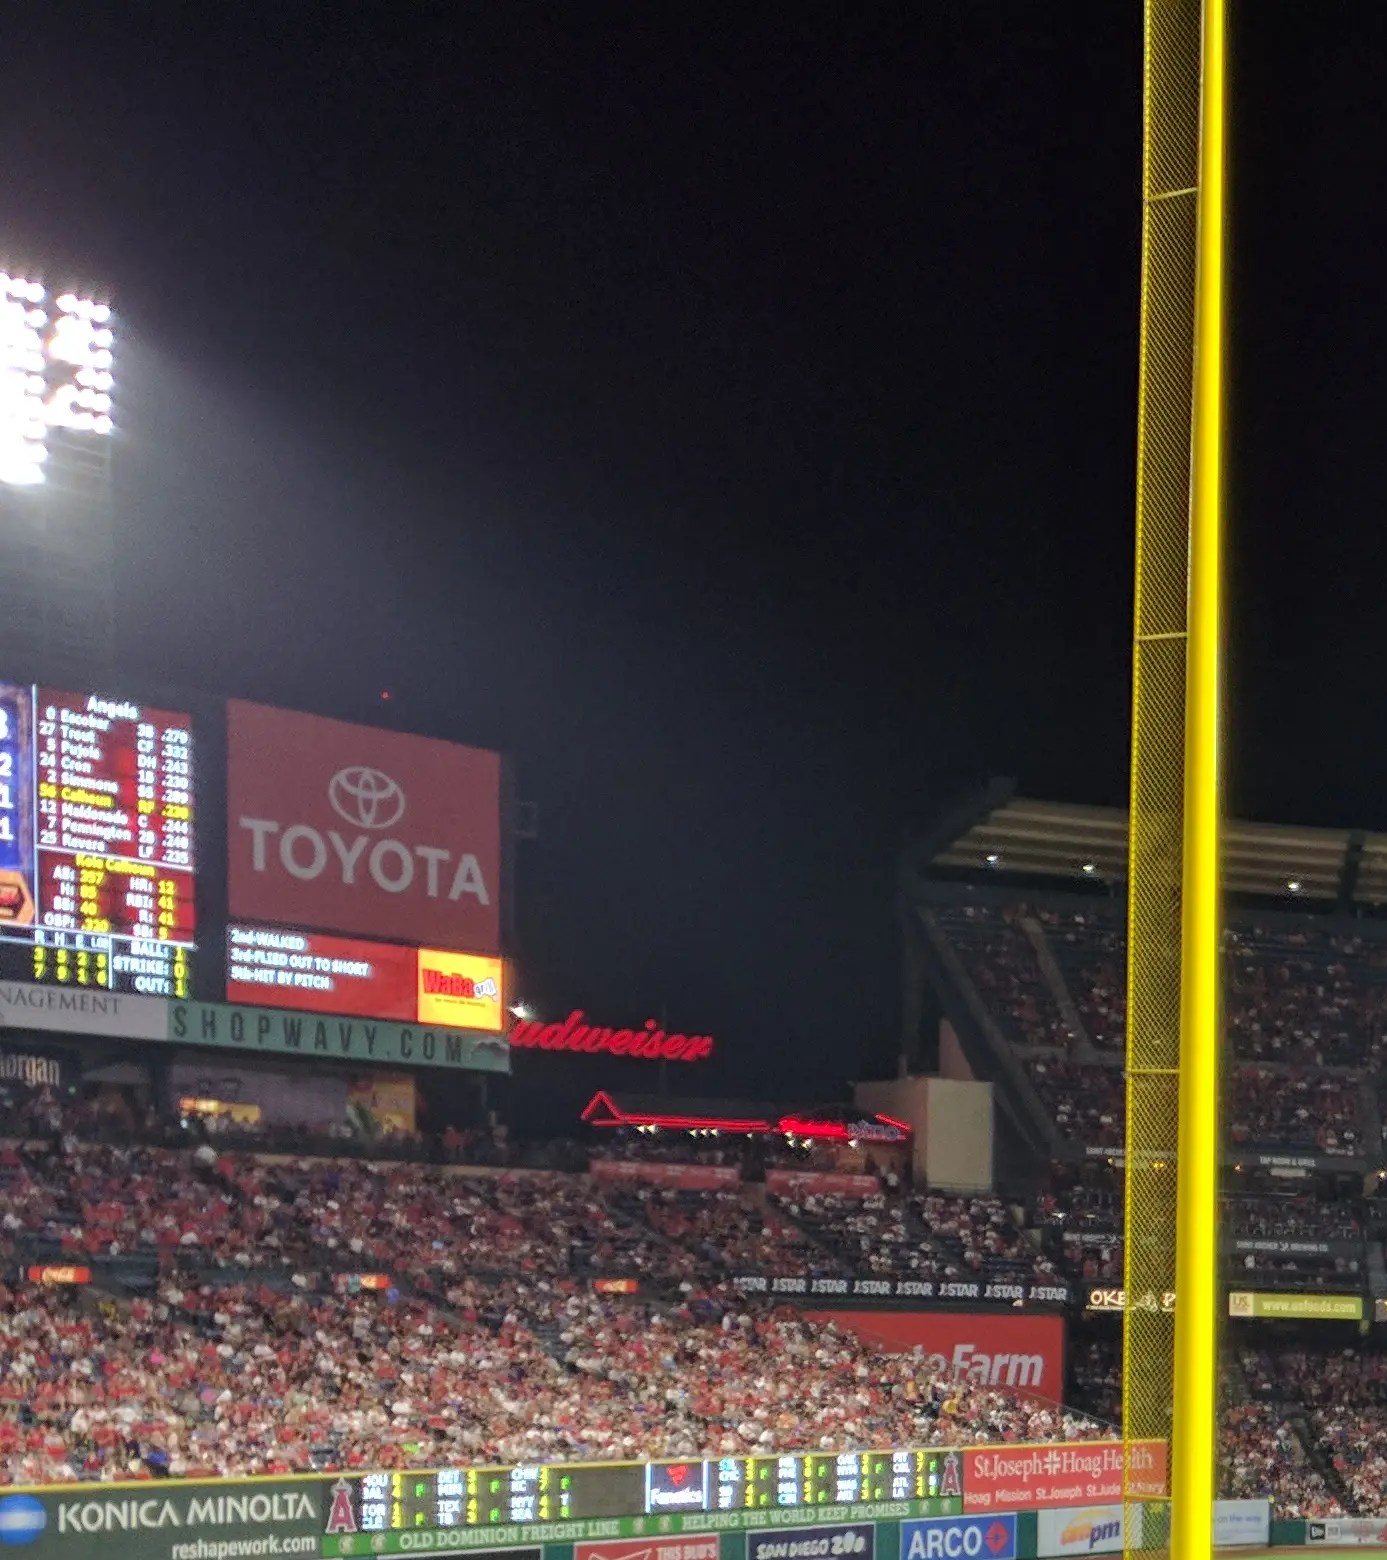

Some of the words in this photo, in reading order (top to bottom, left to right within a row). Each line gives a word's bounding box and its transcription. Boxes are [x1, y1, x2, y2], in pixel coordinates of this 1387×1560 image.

[239, 816, 491, 906] TOYOTA
[130, 941, 169, 957] BALL:
[113, 955, 169, 976] STRIKE:
[289, 954, 314, 970] OUT
[315, 957, 331, 973] TO
[332, 959, 371, 978] SHORT
[134, 976, 169, 994] OUT:
[422, 967, 475, 1000] WaBa
[172, 1005, 463, 1064] SHOPWAVY.COM
[952, 1343, 1044, 1387] Farm
[1061, 1450, 1103, 1480] Hoag
[964, 1491, 992, 1506] Hoag
[995, 1488, 1032, 1503] Mission
[58, 1498, 181, 1534] KONICA
[186, 1492, 317, 1527] MINOLTA
[682, 1511, 741, 1531] HELPING
[742, 1510, 767, 1526] THE
[770, 1506, 816, 1524] WORLD
[818, 1504, 849, 1521] KEEP
[850, 1502, 911, 1520] PROMISES
[172, 1534, 317, 1560] reshapework.com
[400, 1532, 434, 1550] OLD
[439, 1527, 518, 1547] DOMINION
[522, 1522, 585, 1541] FREIGHT
[587, 1519, 619, 1537] LINE
[756, 1541, 788, 1560] SAN
[788, 1538, 829, 1558] DIEGO
[831, 1530, 866, 1556] ZOO
[907, 1525, 983, 1560] ARCO
[1060, 1518, 1121, 1549] ampm
[683, 1543, 717, 1560] BUD'S
